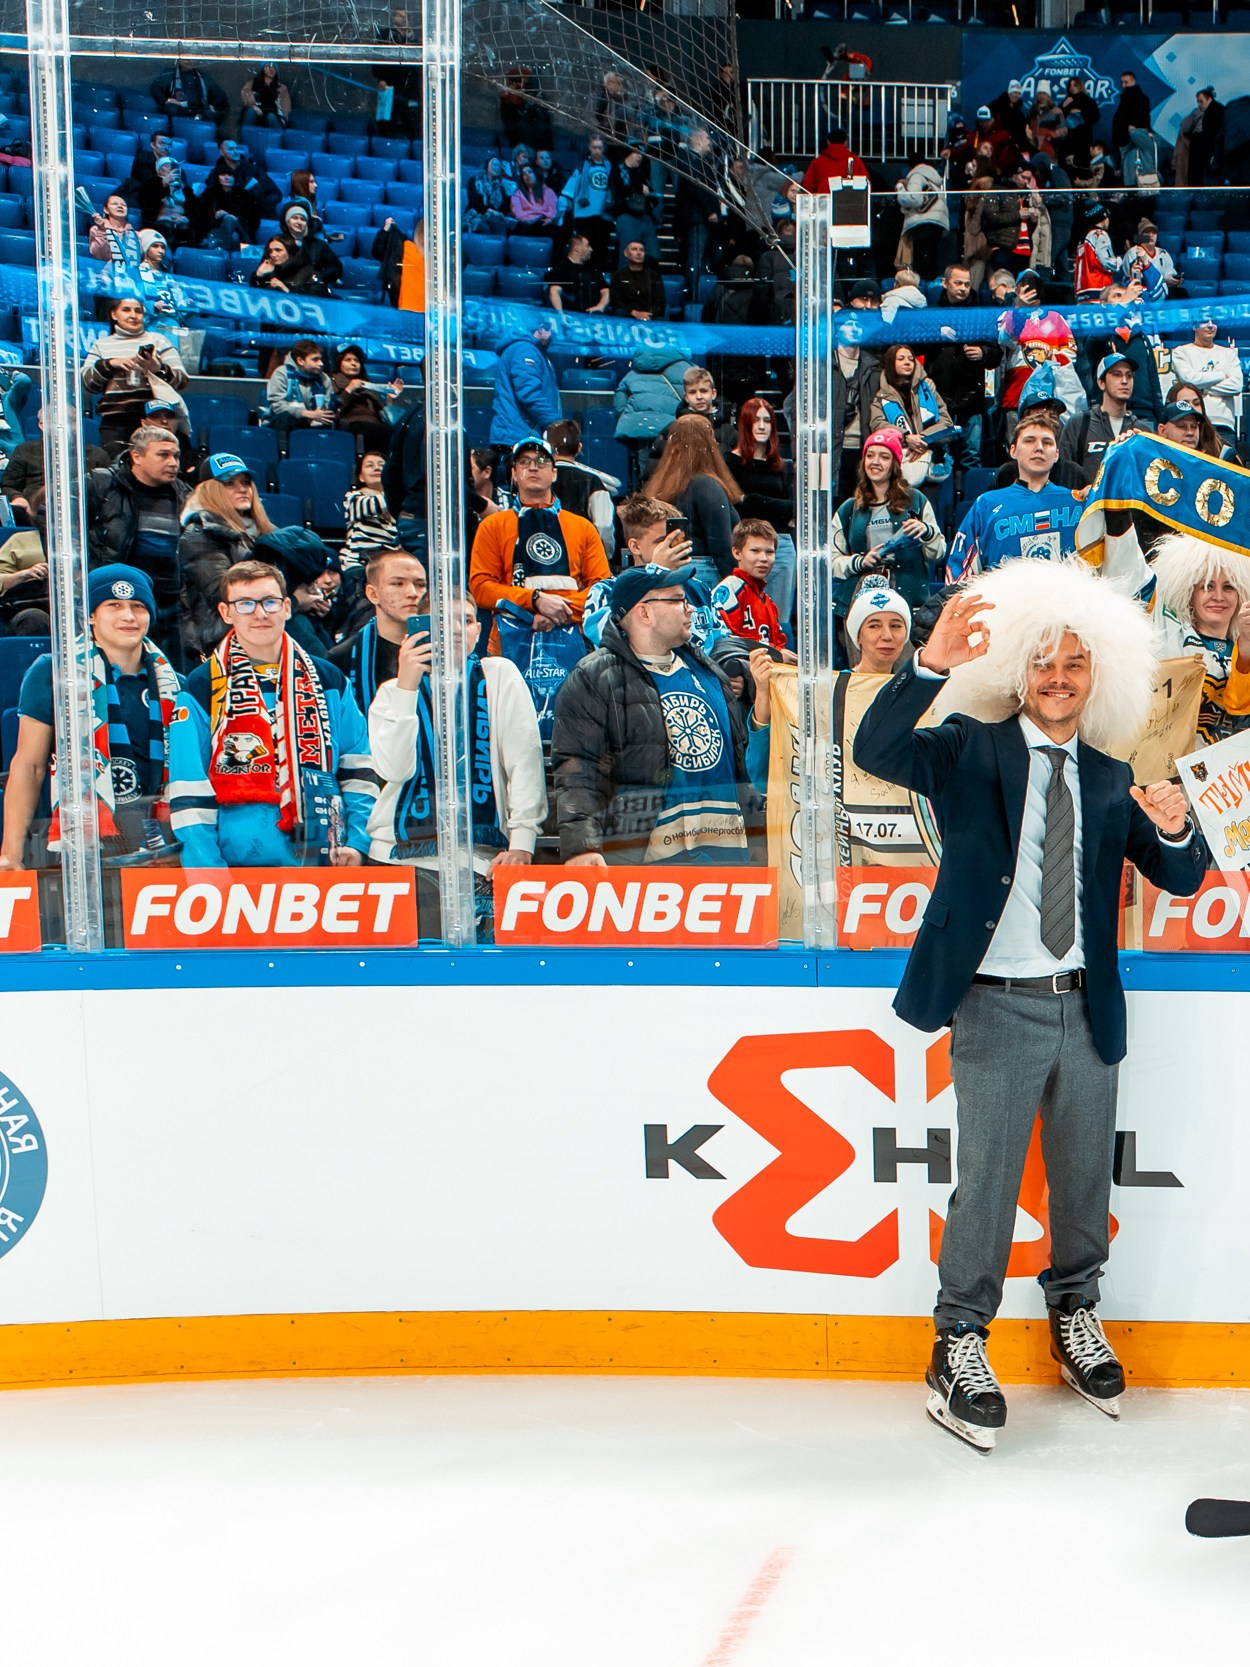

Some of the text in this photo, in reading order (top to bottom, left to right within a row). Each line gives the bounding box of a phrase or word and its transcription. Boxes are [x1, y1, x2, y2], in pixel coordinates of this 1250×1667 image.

[1044, 67, 1081, 76] FONBET
[856, 822, 902, 839] 17.07.
[130, 882, 410, 936] FONBET
[500, 881, 772, 934] FONBET
